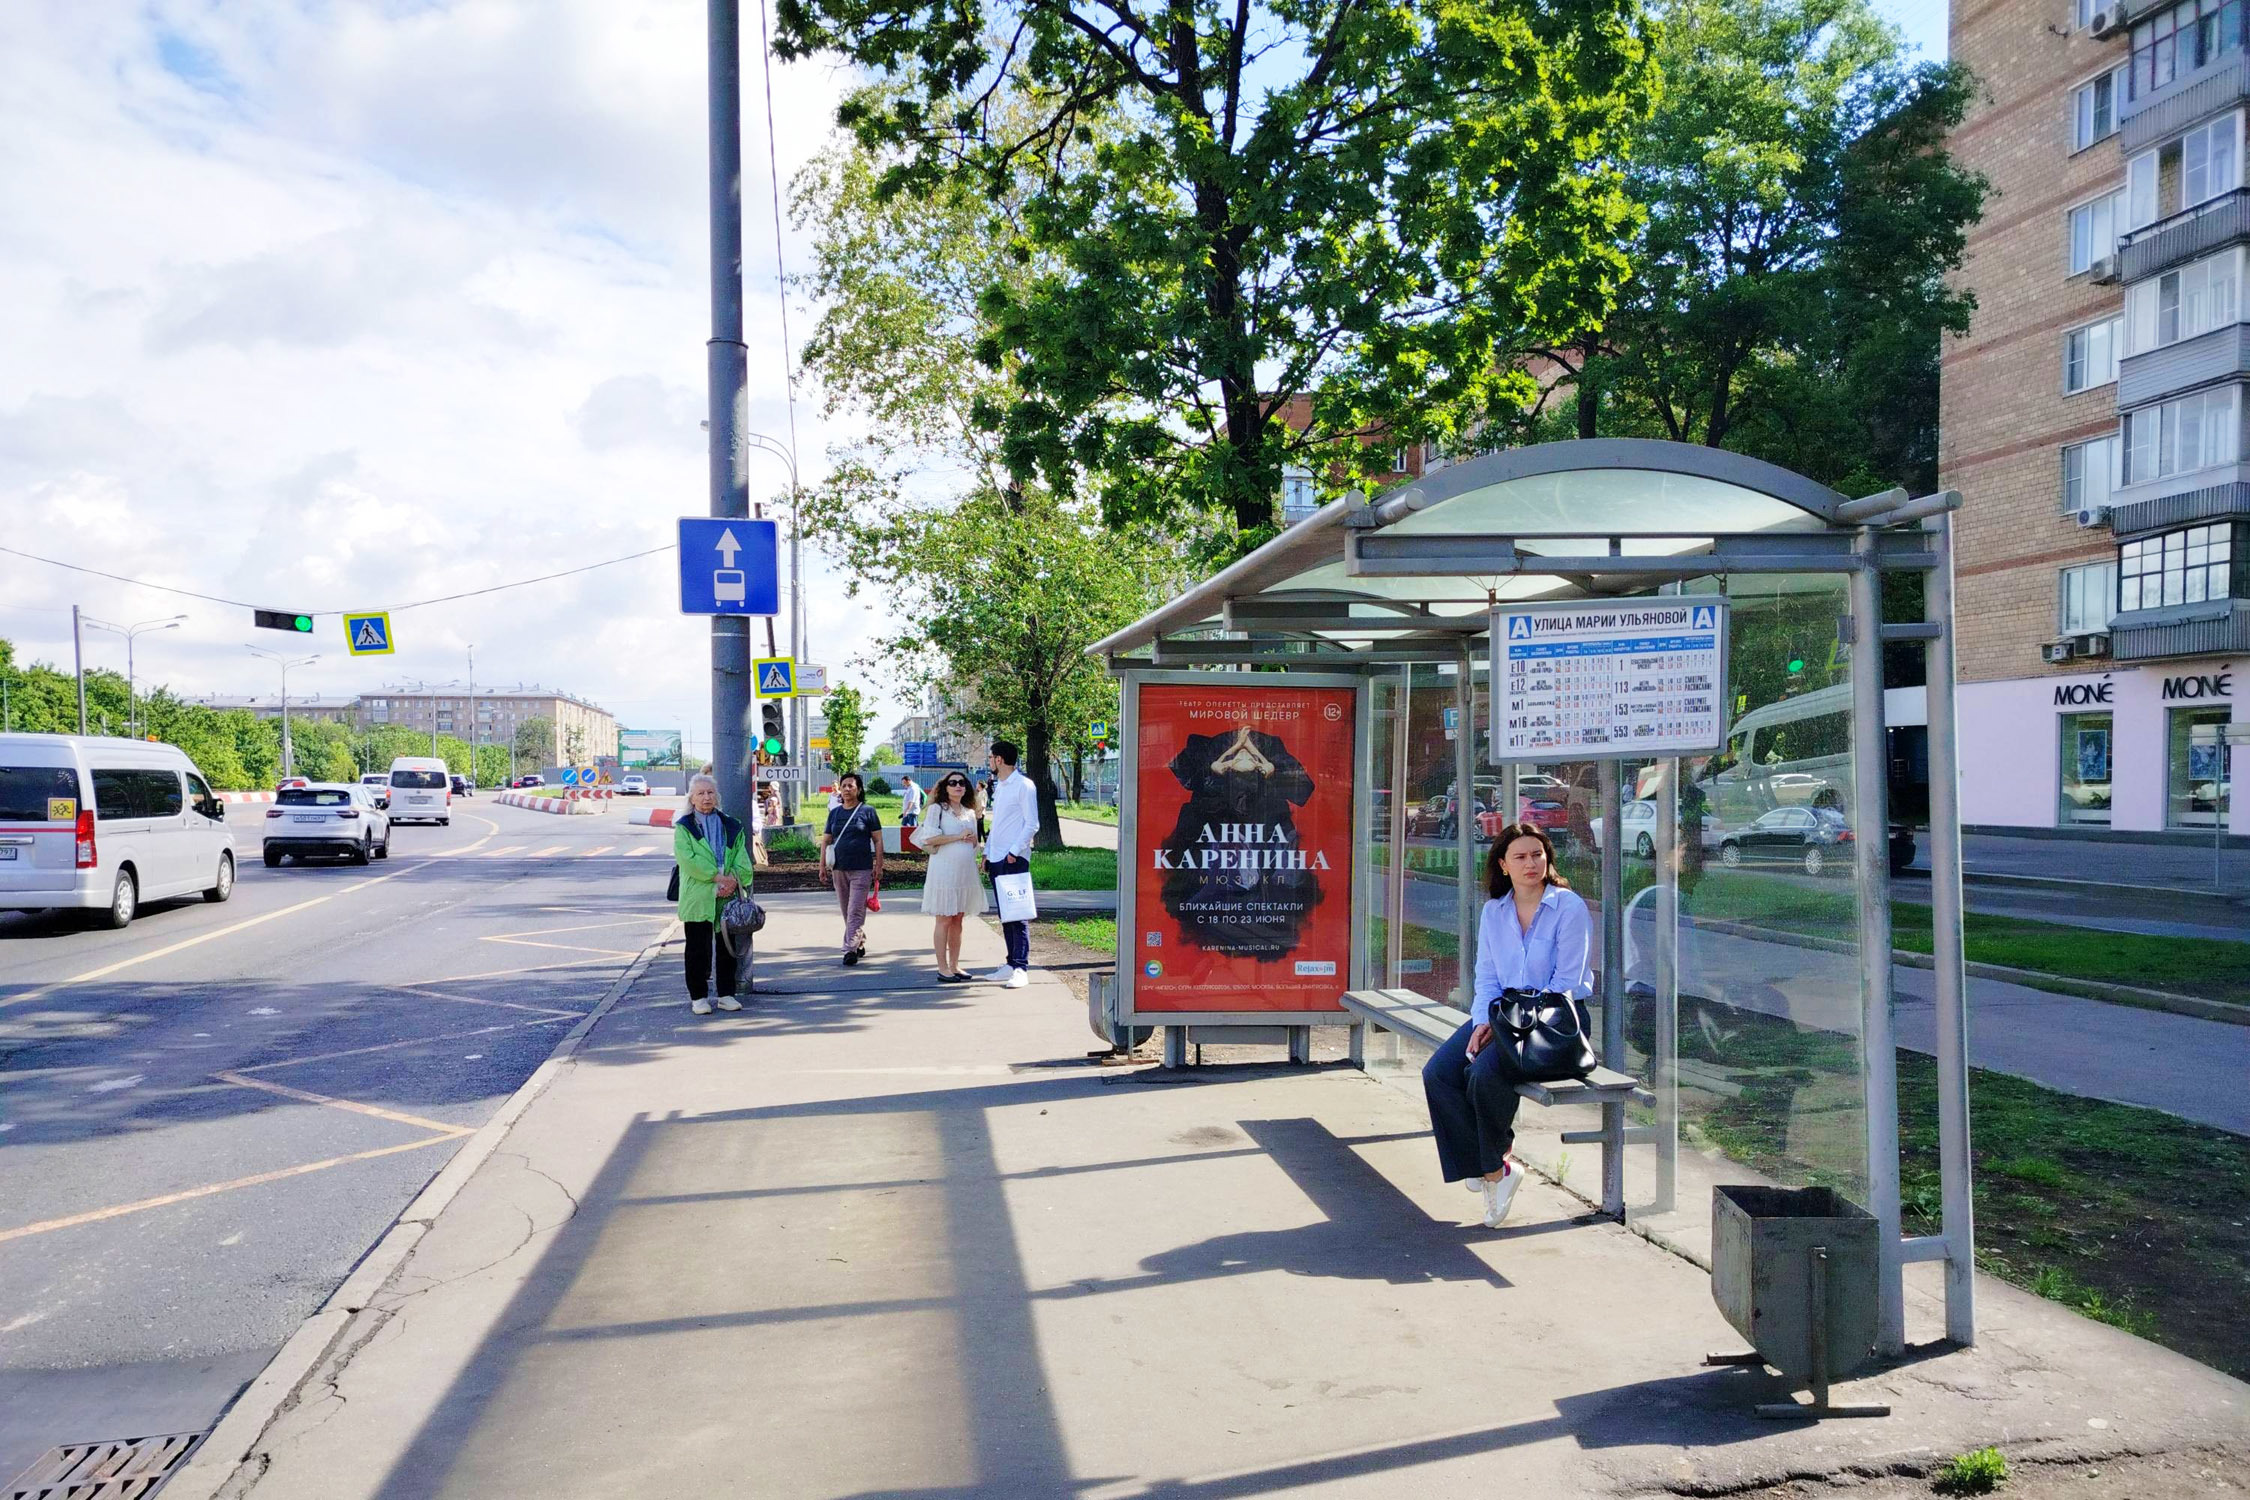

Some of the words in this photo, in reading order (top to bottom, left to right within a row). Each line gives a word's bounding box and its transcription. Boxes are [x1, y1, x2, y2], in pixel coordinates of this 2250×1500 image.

[1534, 617, 1572, 632] УЛИЦА
[1576, 614, 1616, 629] МАРИИ
[1620, 608, 1687, 627] УЛЬЯНОВОЙ
[1614, 681, 1629, 694] 113
[2162, 664, 2232, 699] MONÉ
[2054, 673, 2114, 705] MONÉ
[1189, 708, 1248, 720] МИРОВОЙ
[1253, 710, 1300, 720] ШЕДЕВР
[1614, 703, 1629, 716] 153
[1509, 716, 1527, 728] М16
[1614, 725, 1629, 738] 553
[766, 769, 799, 779] СТОП
[1195, 822, 1289, 843] АННА
[1153, 849, 1331, 870] КАРЕНИНА
[1199, 875, 1285, 885] МЮЗИКЛ
[1179, 901, 1242, 911] БЛИЖАЙШИЕ
[1246, 902, 1303, 911] СПЕКТАКЛИ
[1197, 916, 1205, 924] С
[1208, 916, 1218, 924] 18
[1222, 916, 1238, 924] ПО
[1240, 916, 1252, 924] 23
[1256, 915, 1285, 923] ИЮНЯ
